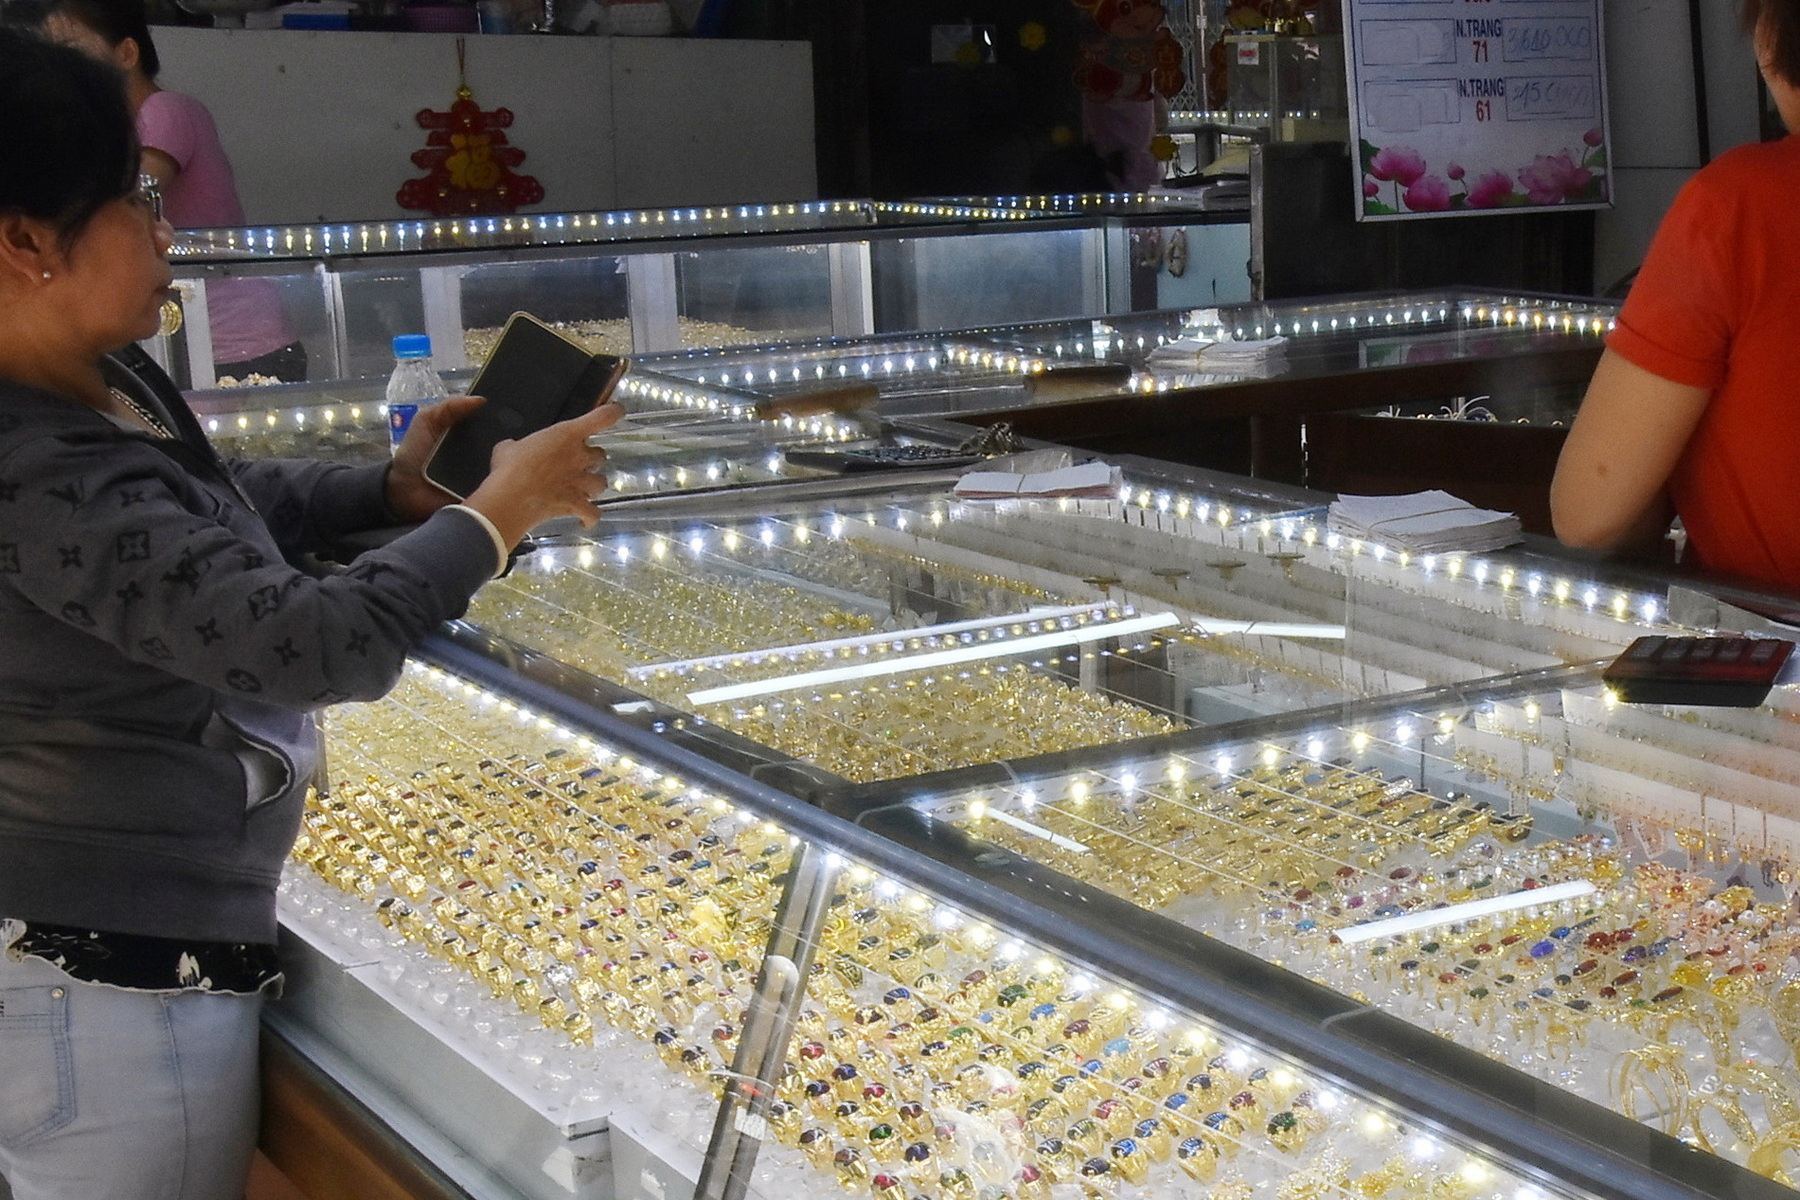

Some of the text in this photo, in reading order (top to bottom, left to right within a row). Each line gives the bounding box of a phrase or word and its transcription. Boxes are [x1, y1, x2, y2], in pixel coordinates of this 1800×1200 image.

[1456, 18, 1502, 38] N.TRANG
[1472, 41, 1489, 63] 71
[1459, 78, 1504, 98] N.TRANG
[1475, 100, 1491, 122] 61
